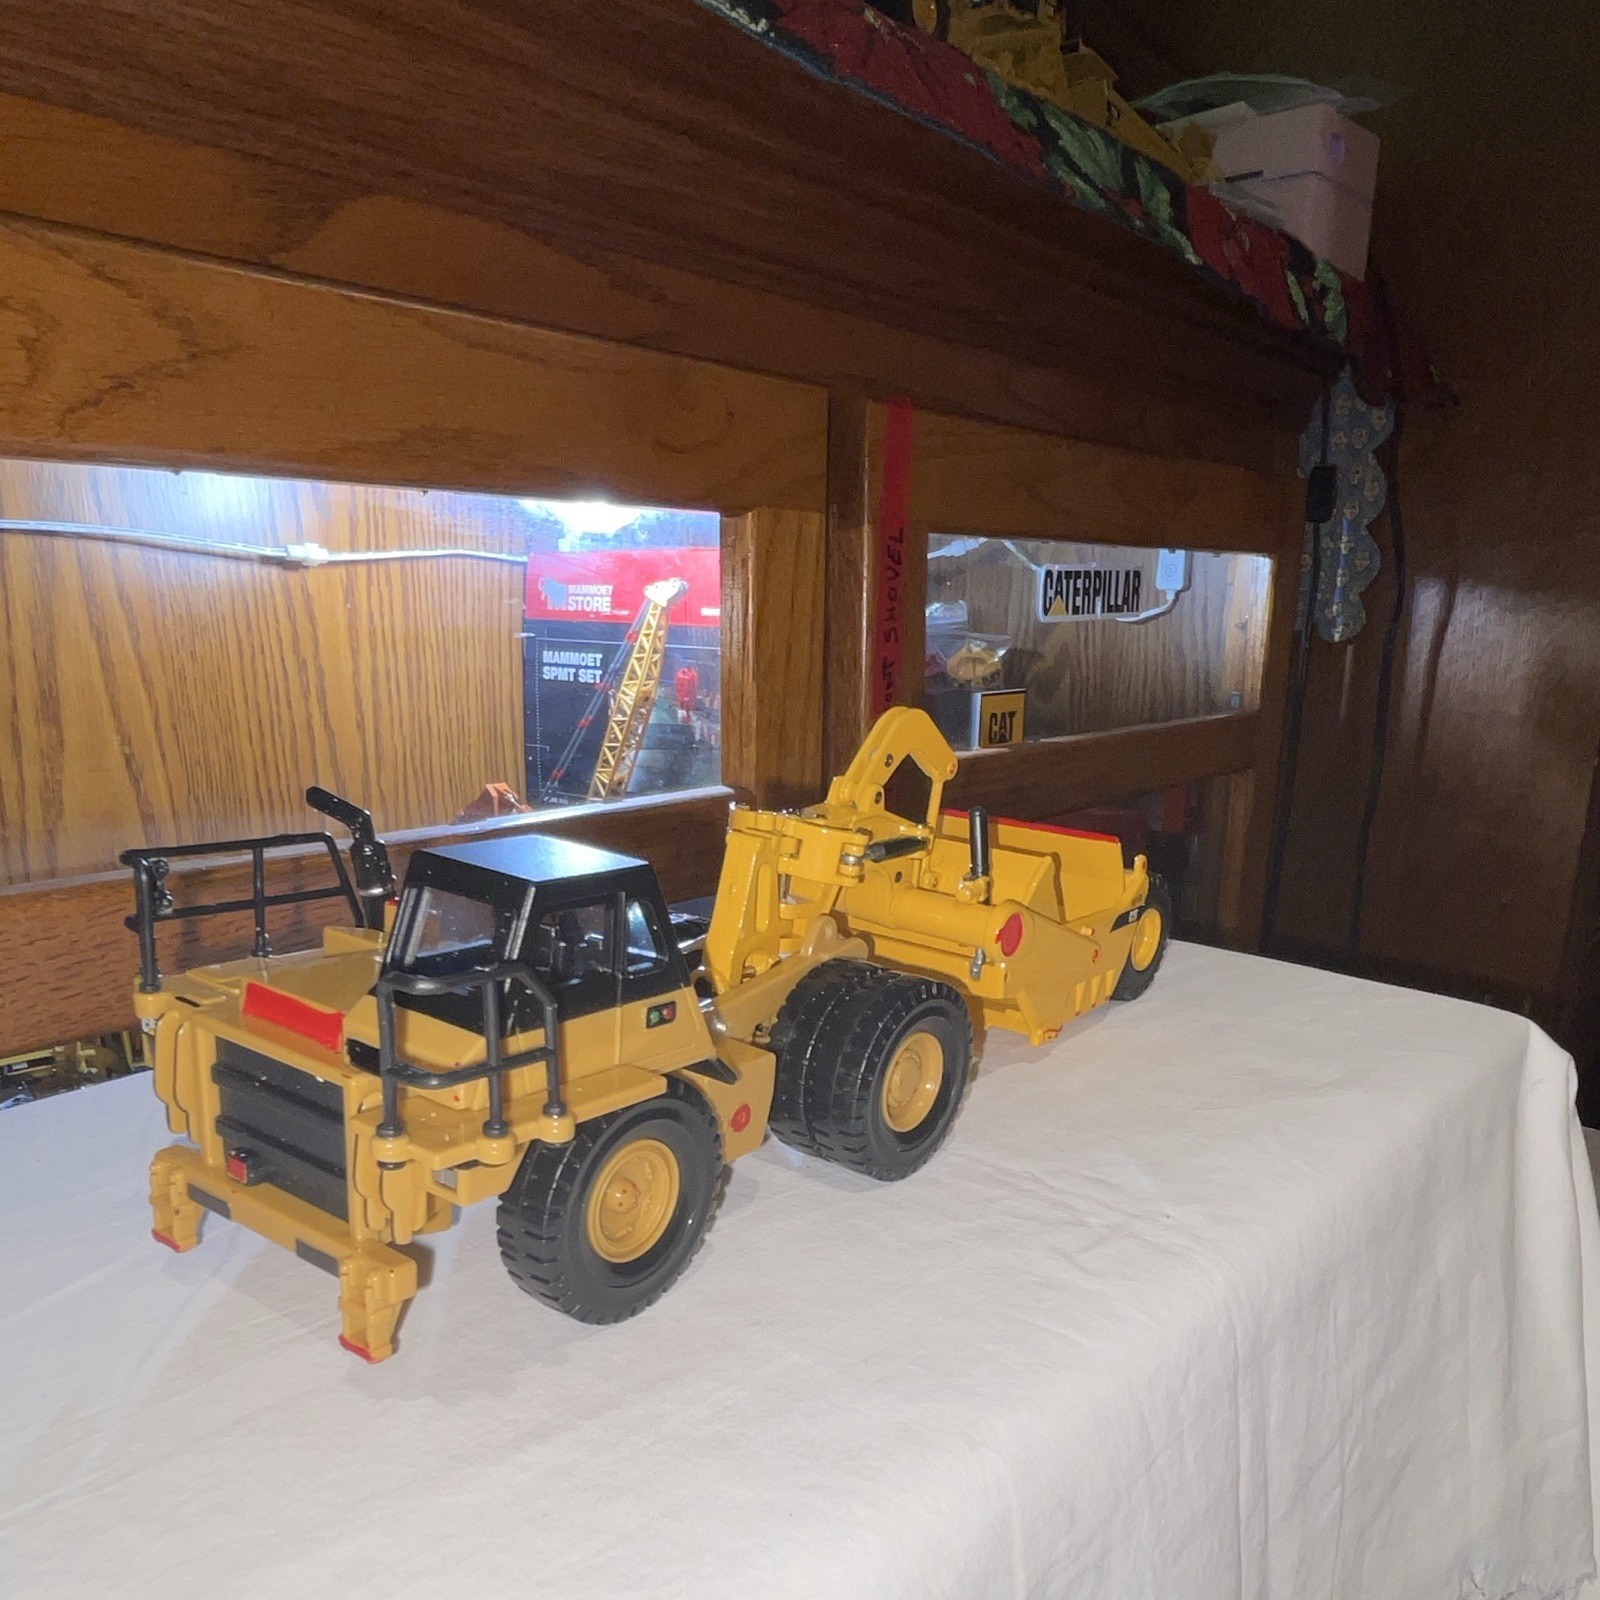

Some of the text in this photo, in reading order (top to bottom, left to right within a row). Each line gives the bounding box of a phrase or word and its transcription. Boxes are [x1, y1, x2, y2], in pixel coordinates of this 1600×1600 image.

[568, 584, 613, 596] MAMMOET
[1043, 569, 1141, 615] CATERPILLAR
[567, 596, 612, 612] STORE
[542, 650, 603, 667] MAMMOET
[542, 667, 603, 684] SPMT SET
[989, 711, 1016, 744] CAT
